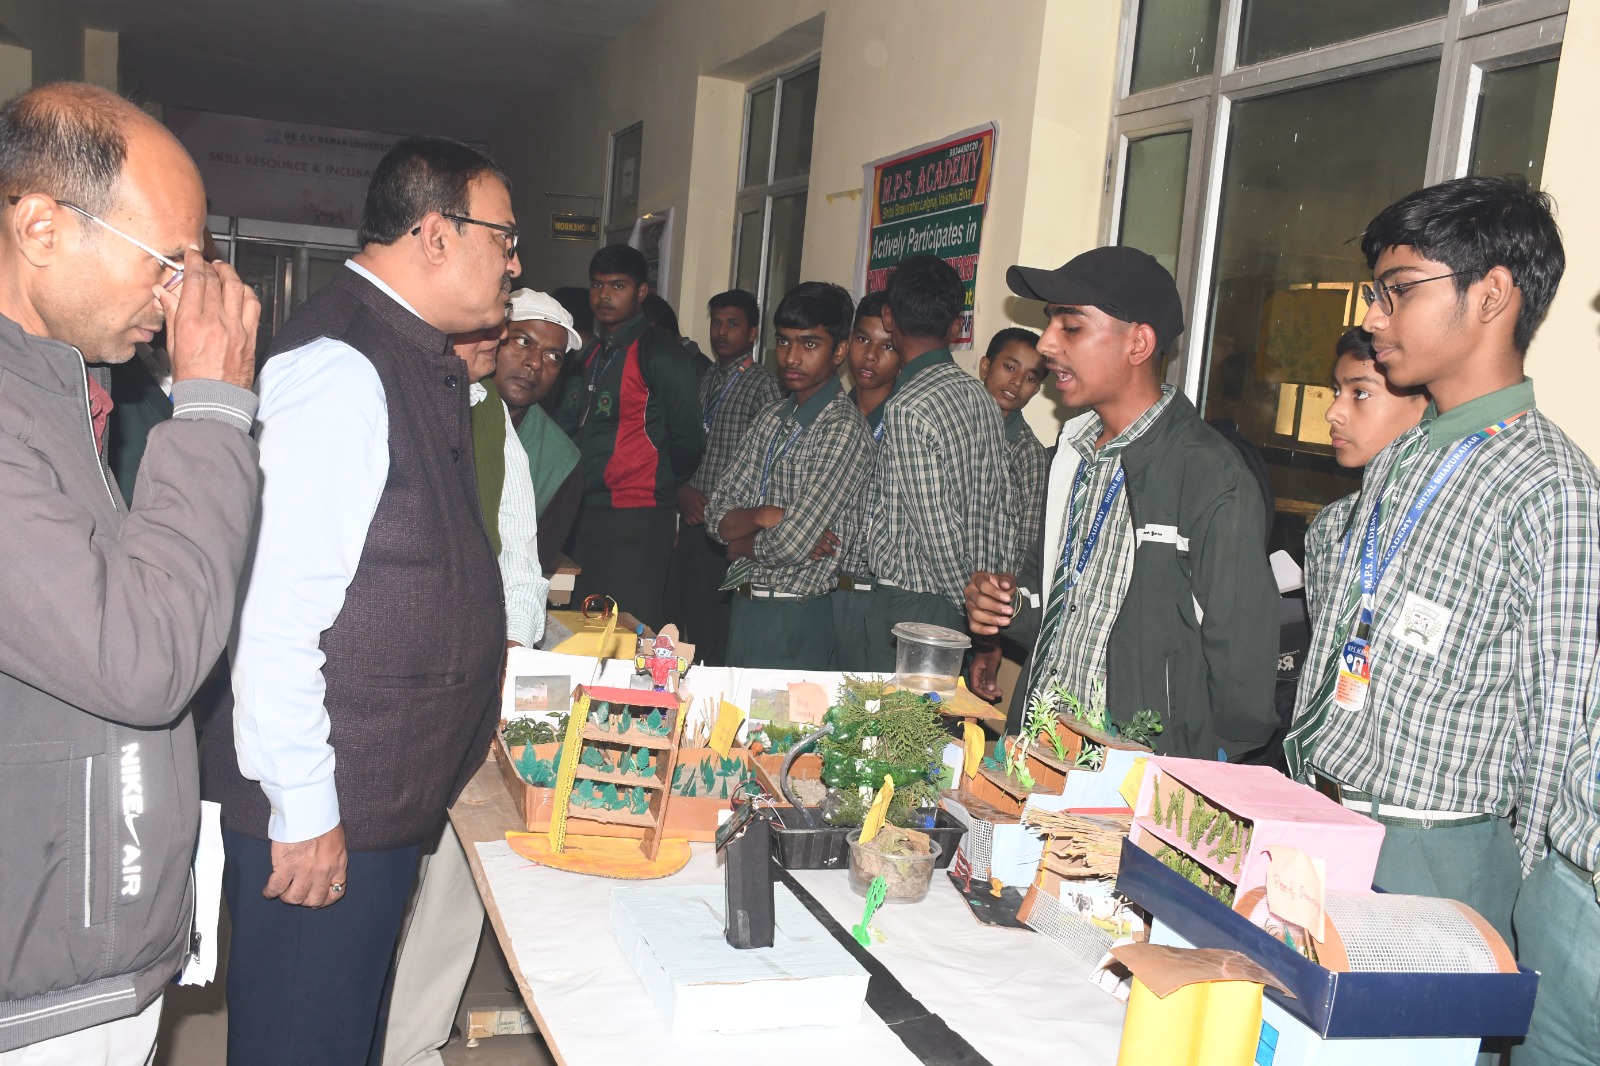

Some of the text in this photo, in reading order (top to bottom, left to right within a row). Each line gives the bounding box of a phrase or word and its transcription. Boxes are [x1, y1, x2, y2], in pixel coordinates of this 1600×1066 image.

[209, 152, 240, 164] SKILL
[244, 155, 308, 172] RESOURCE
[312, 164, 321, 173] &
[284, 132, 298, 141] DR.
[300, 134, 317, 143] C.V.
[317, 136, 348, 147] RAMAN
[350, 140, 394, 151] UNIVERSIT
[881, 142, 983, 204] M.P.S. ACADEMY
[871, 216, 977, 260] Actively Participates in
[1078, 547, 1090, 569] M.P.S.
[1087, 508, 1105, 548] ACADEMY
[1104, 481, 1119, 504] SHITAL
[1385, 517, 1413, 564] ACADEMY
[1415, 483, 1437, 511] SHITAL
[1434, 436, 1480, 485] BHAKURAHAR
[1364, 511, 1378, 590] M.P.S. ACADEMY
[121, 742, 144, 896] NIKE AIR
